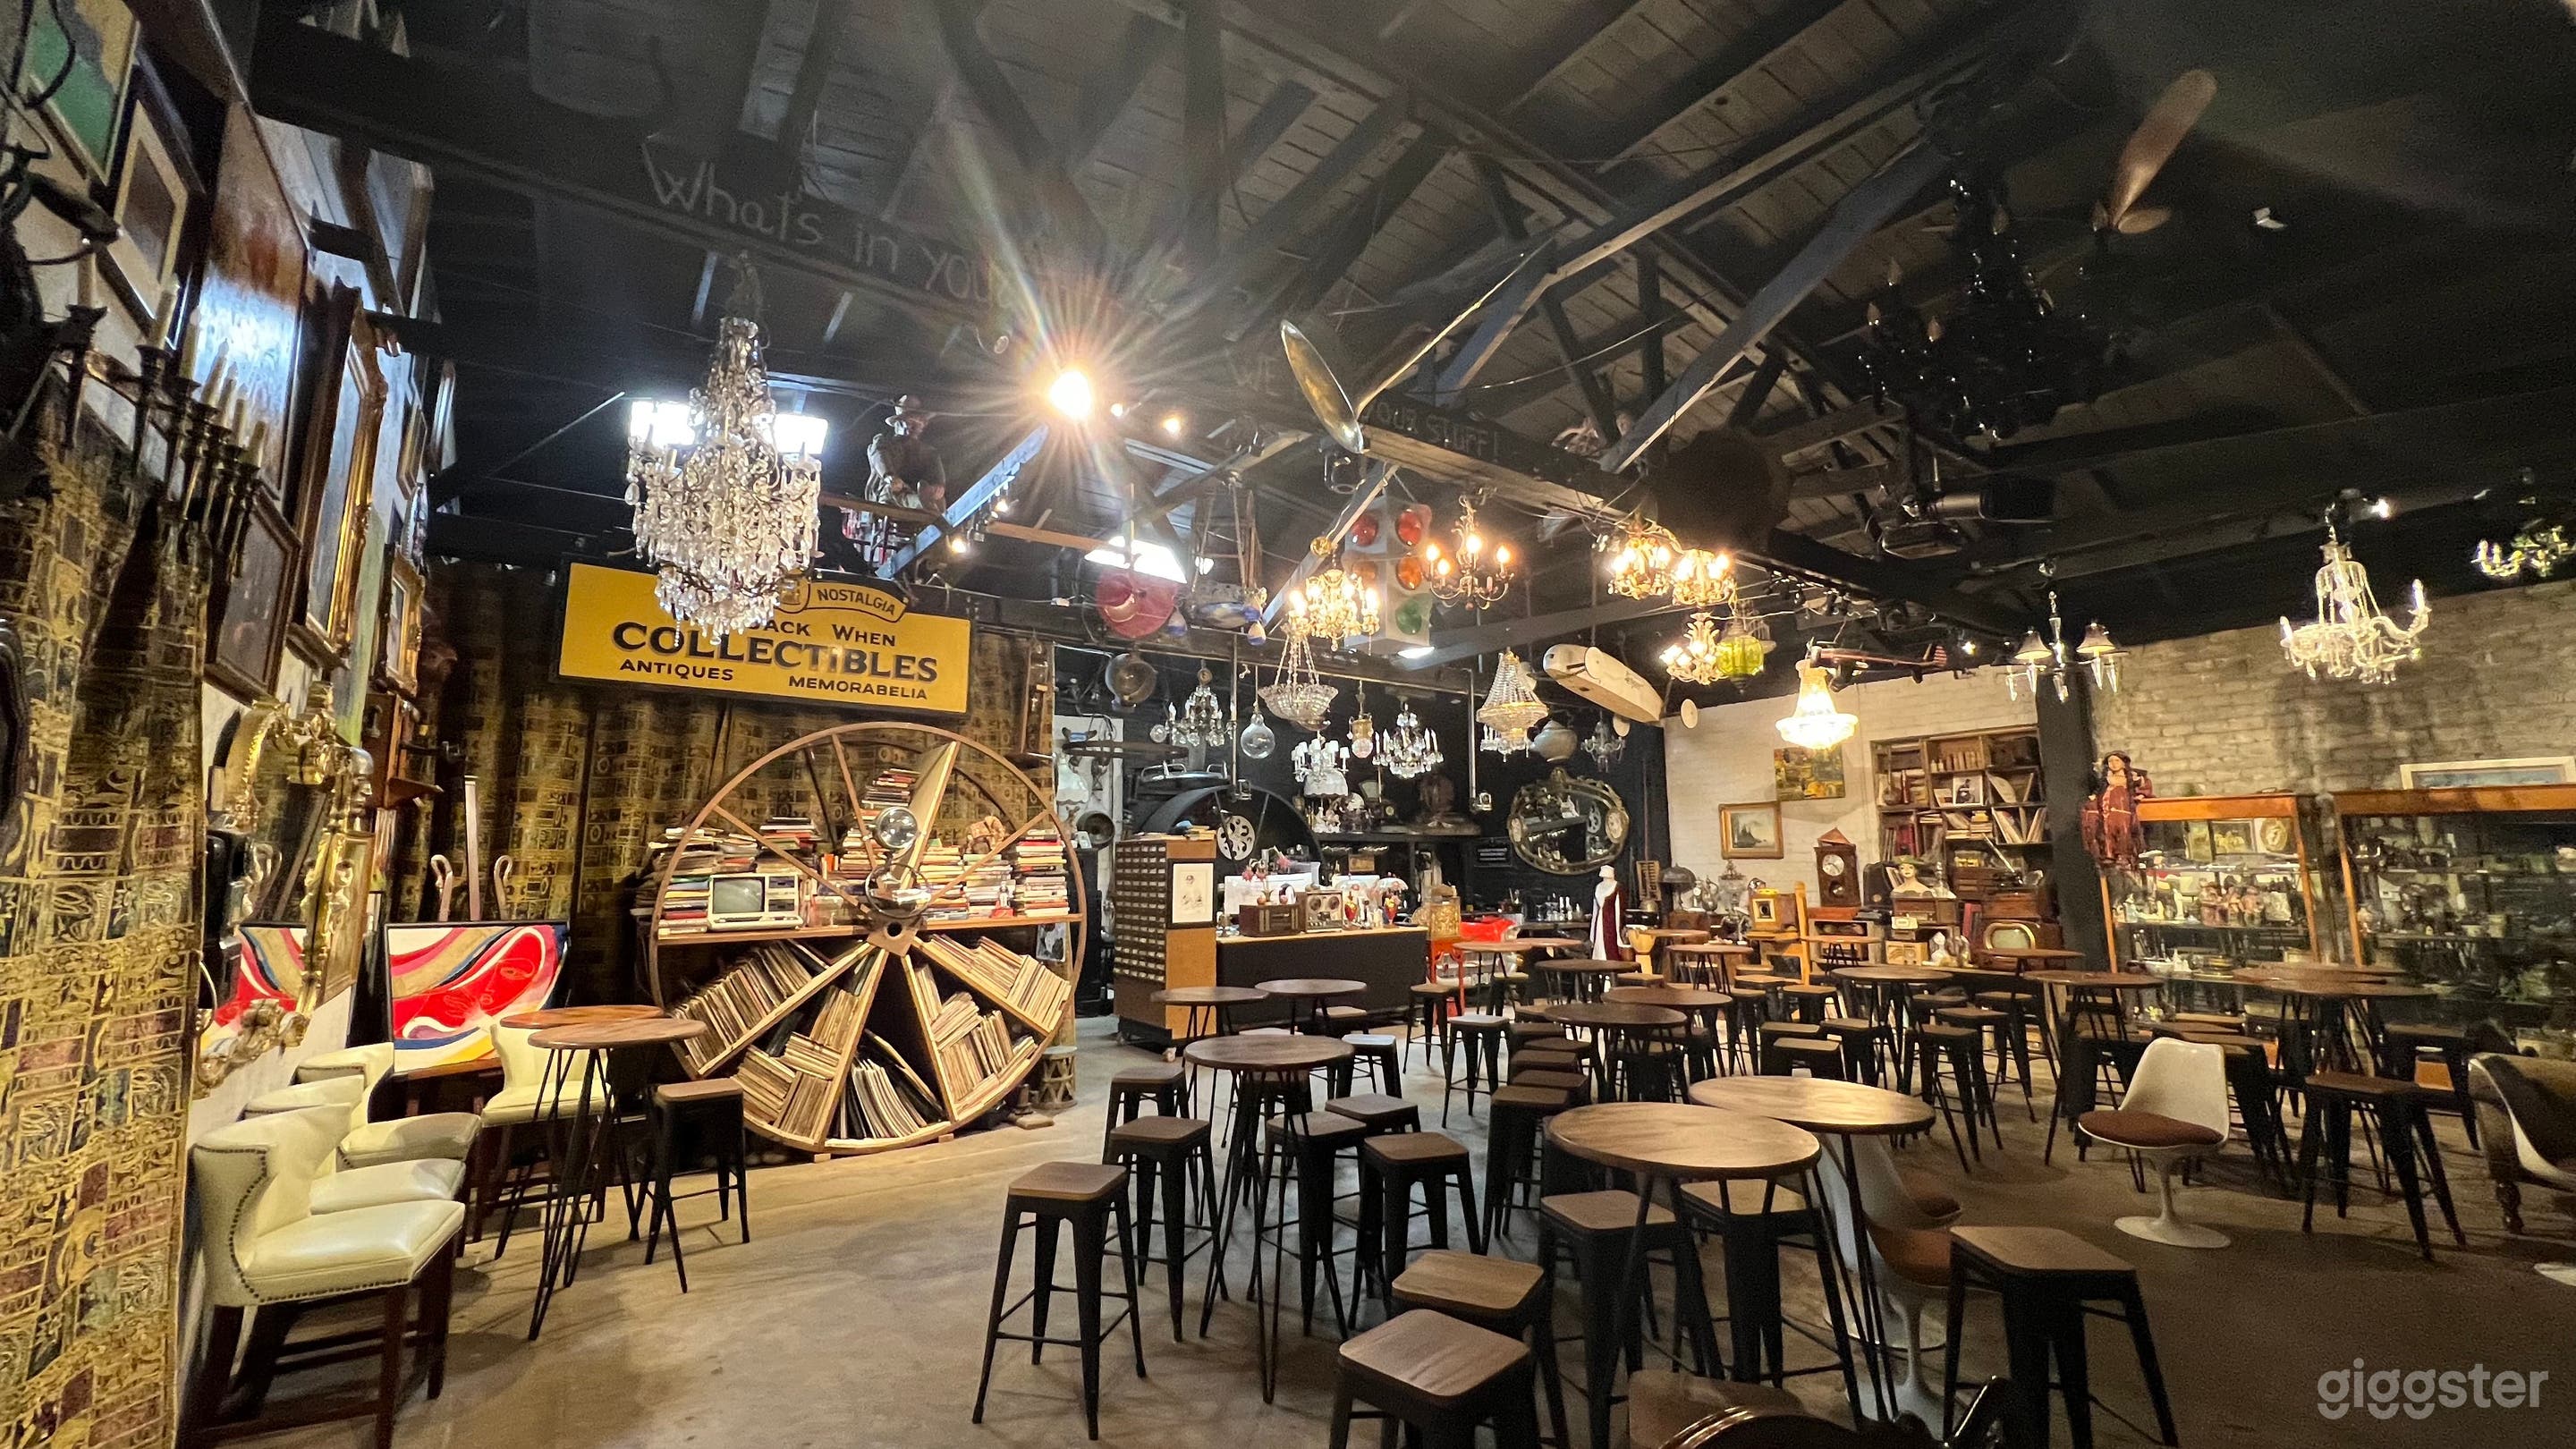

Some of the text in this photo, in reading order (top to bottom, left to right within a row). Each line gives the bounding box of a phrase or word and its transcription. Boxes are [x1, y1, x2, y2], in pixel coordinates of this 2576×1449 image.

[855, 223, 899, 275] in
[817, 589, 896, 615] NOSTALGIA
[612, 621, 937, 684] COLLECTIBLES
[619, 658, 928, 699] ANTIQUES MEMORABELIA
